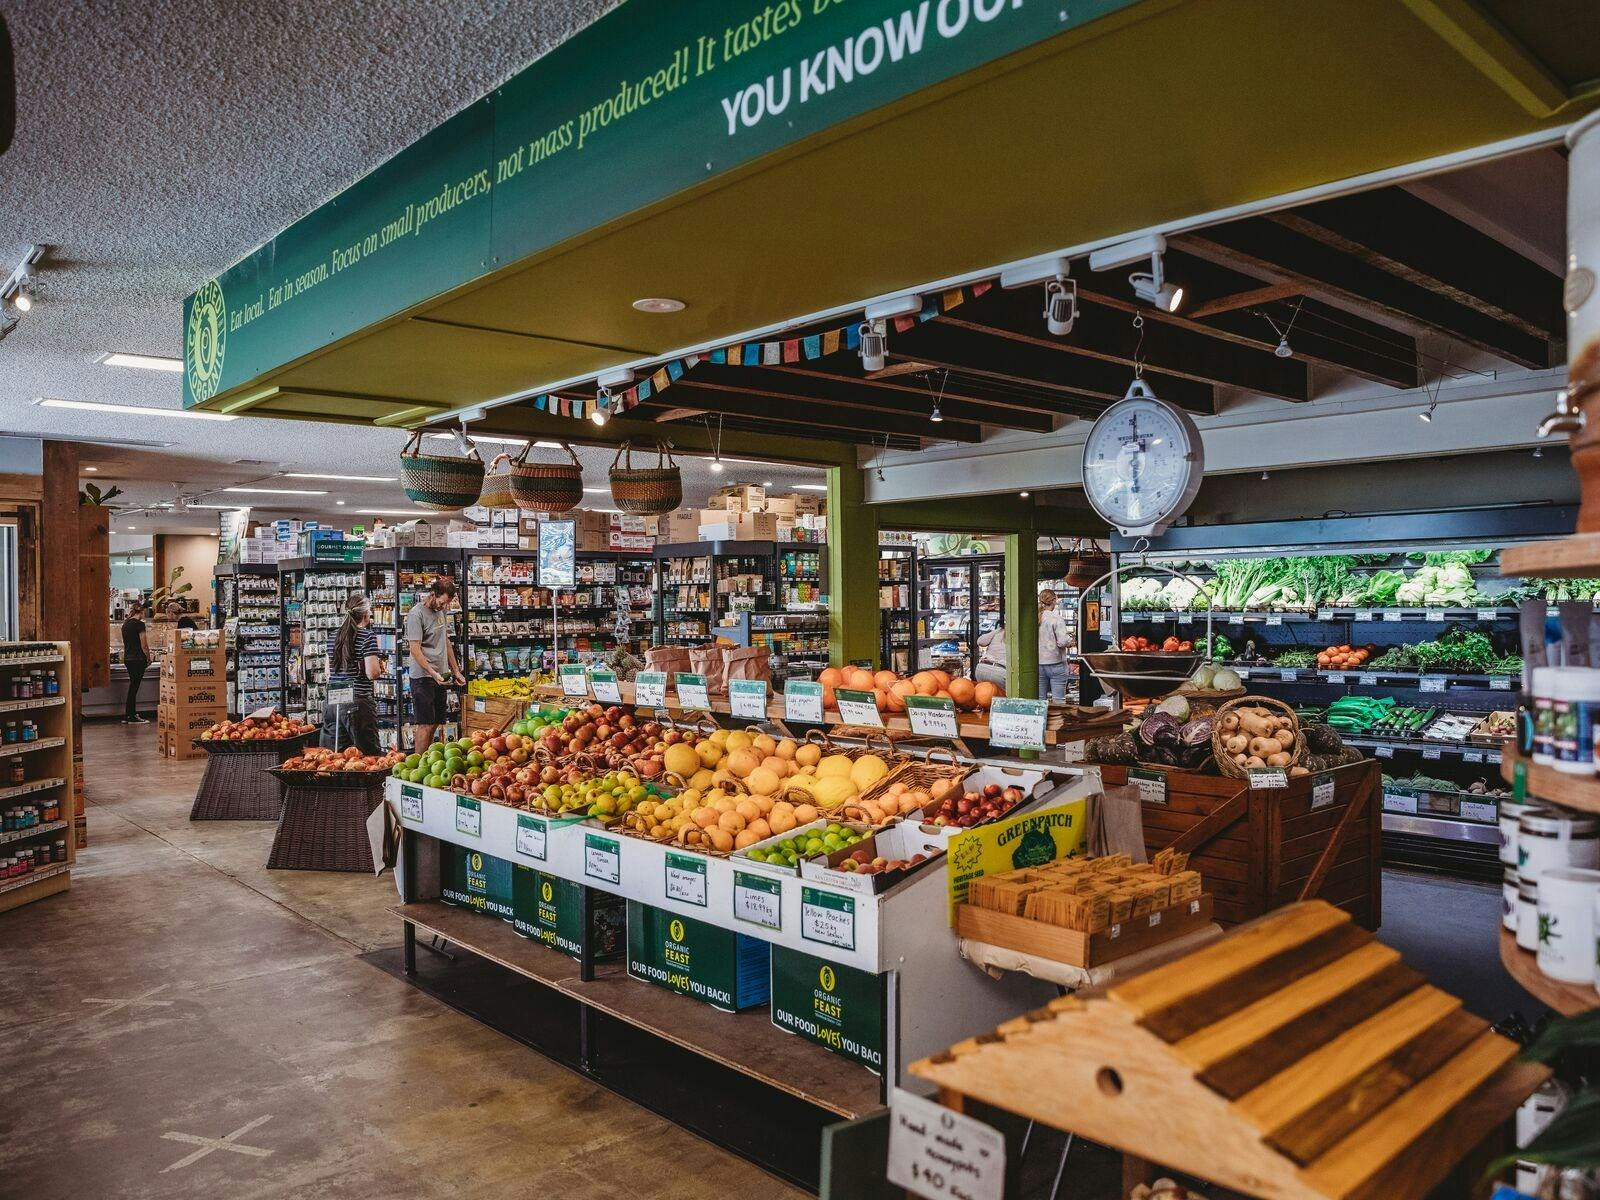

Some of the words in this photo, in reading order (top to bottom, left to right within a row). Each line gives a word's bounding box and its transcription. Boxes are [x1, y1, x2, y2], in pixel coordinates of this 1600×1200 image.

[721, 67, 792, 136] YOU
[800, 1, 930, 103] KNOW
[231, 310, 244, 332] Eat
[244, 294, 265, 325] local.
[268, 285, 283, 311] Eat
[284, 279, 293, 301] in
[295, 263, 329, 296] season.
[331, 242, 361, 275] Focus
[363, 233, 378, 257] on
[380, 204, 414, 247] small
[415, 168, 492, 236] producers,
[497, 145, 525, 184] not
[528, 120, 574, 167] mass
[577, 46, 689, 150] produced!
[696, 36, 717, 77] It
[723, 0, 802, 62] tastes
[188, 694, 216, 704] BOULDER
[997, 813, 1073, 847] GREENPATCH
[468, 872, 486, 881] ORGANIC
[468, 878, 487, 889] FEAST
[443, 888, 455, 900] OUR
[455, 892, 470, 904] FOOD
[486, 900, 499, 913] YOU
[745, 890, 765, 903] Limes
[538, 900, 557, 913] ORGANIC
[538, 908, 557, 922] FEAST
[804, 905, 822, 918] Yellow
[825, 910, 850, 926] Peaches
[514, 919, 526, 931] OUR
[526, 924, 540, 937] FOOD
[556, 934, 568, 949] YOU
[665, 940, 690, 955] ORGANIC
[665, 949, 690, 965] FEAST
[632, 961, 647, 974] OUR
[647, 966, 668, 981] FOOD
[689, 980, 706, 995] YOU
[707, 986, 731, 1004] BACK!
[814, 989, 841, 1007] ORGANIC
[814, 998, 841, 1018] FEAST
[777, 1009, 794, 1025] OUR
[794, 1017, 816, 1035] FOOD
[841, 1036, 860, 1055] YOU
